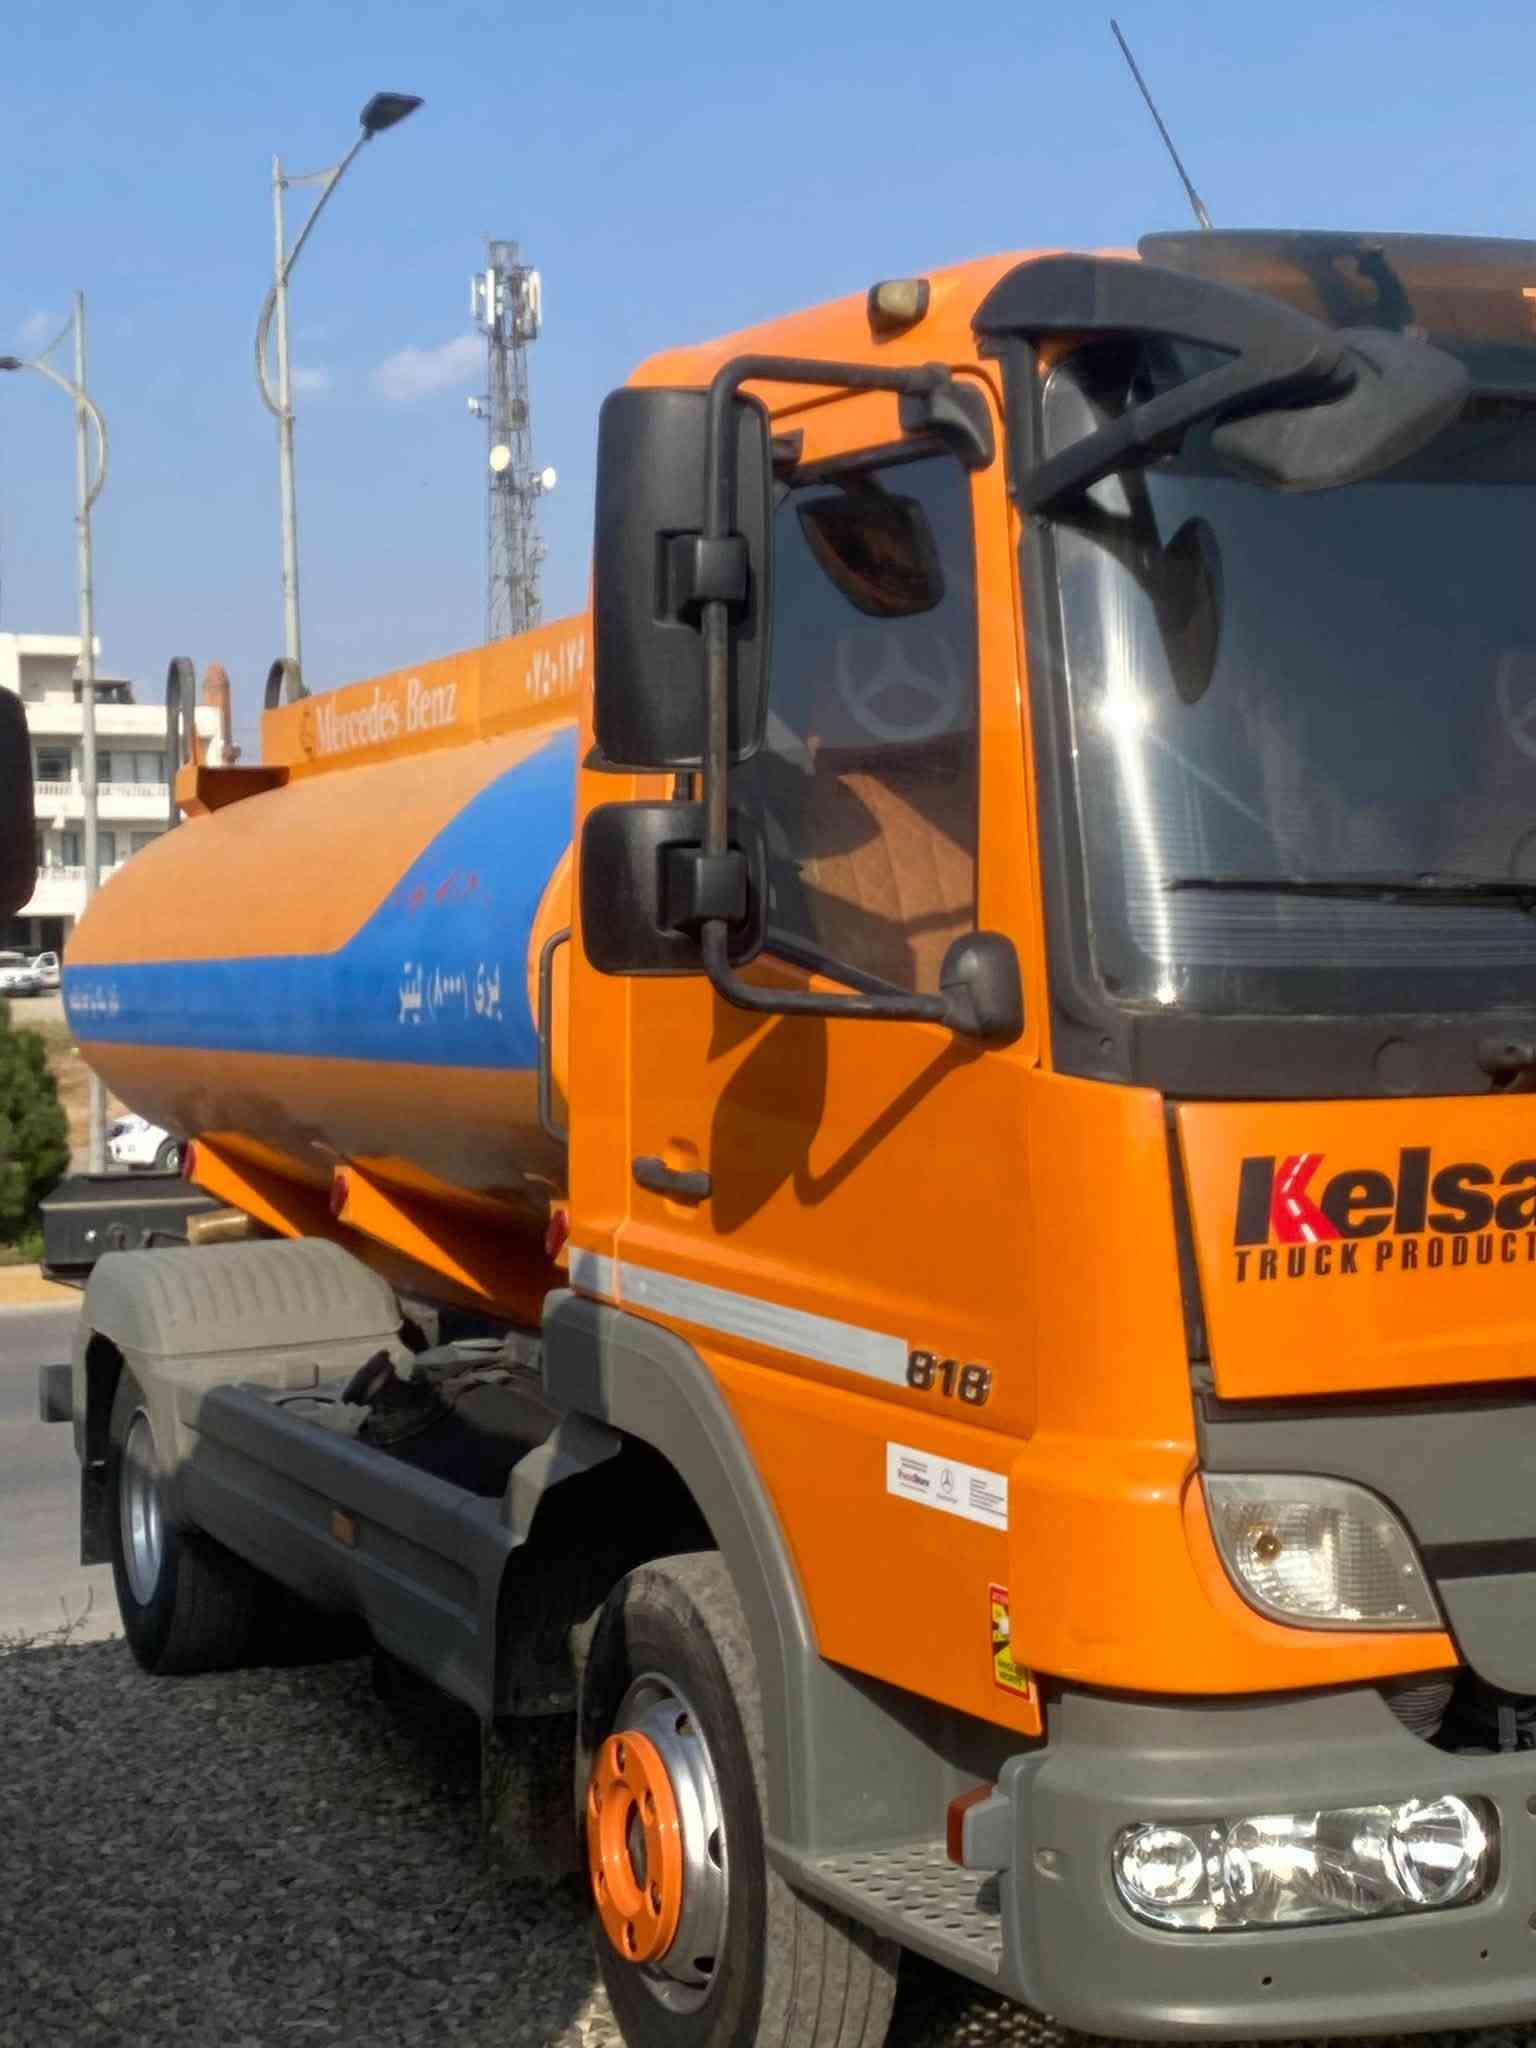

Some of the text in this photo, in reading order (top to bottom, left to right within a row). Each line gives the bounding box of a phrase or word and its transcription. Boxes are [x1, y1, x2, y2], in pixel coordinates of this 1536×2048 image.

[407, 677, 458, 732] Benz
[1234, 1242, 1358, 1283] TRUCK
[906, 1350, 992, 1407] 818
